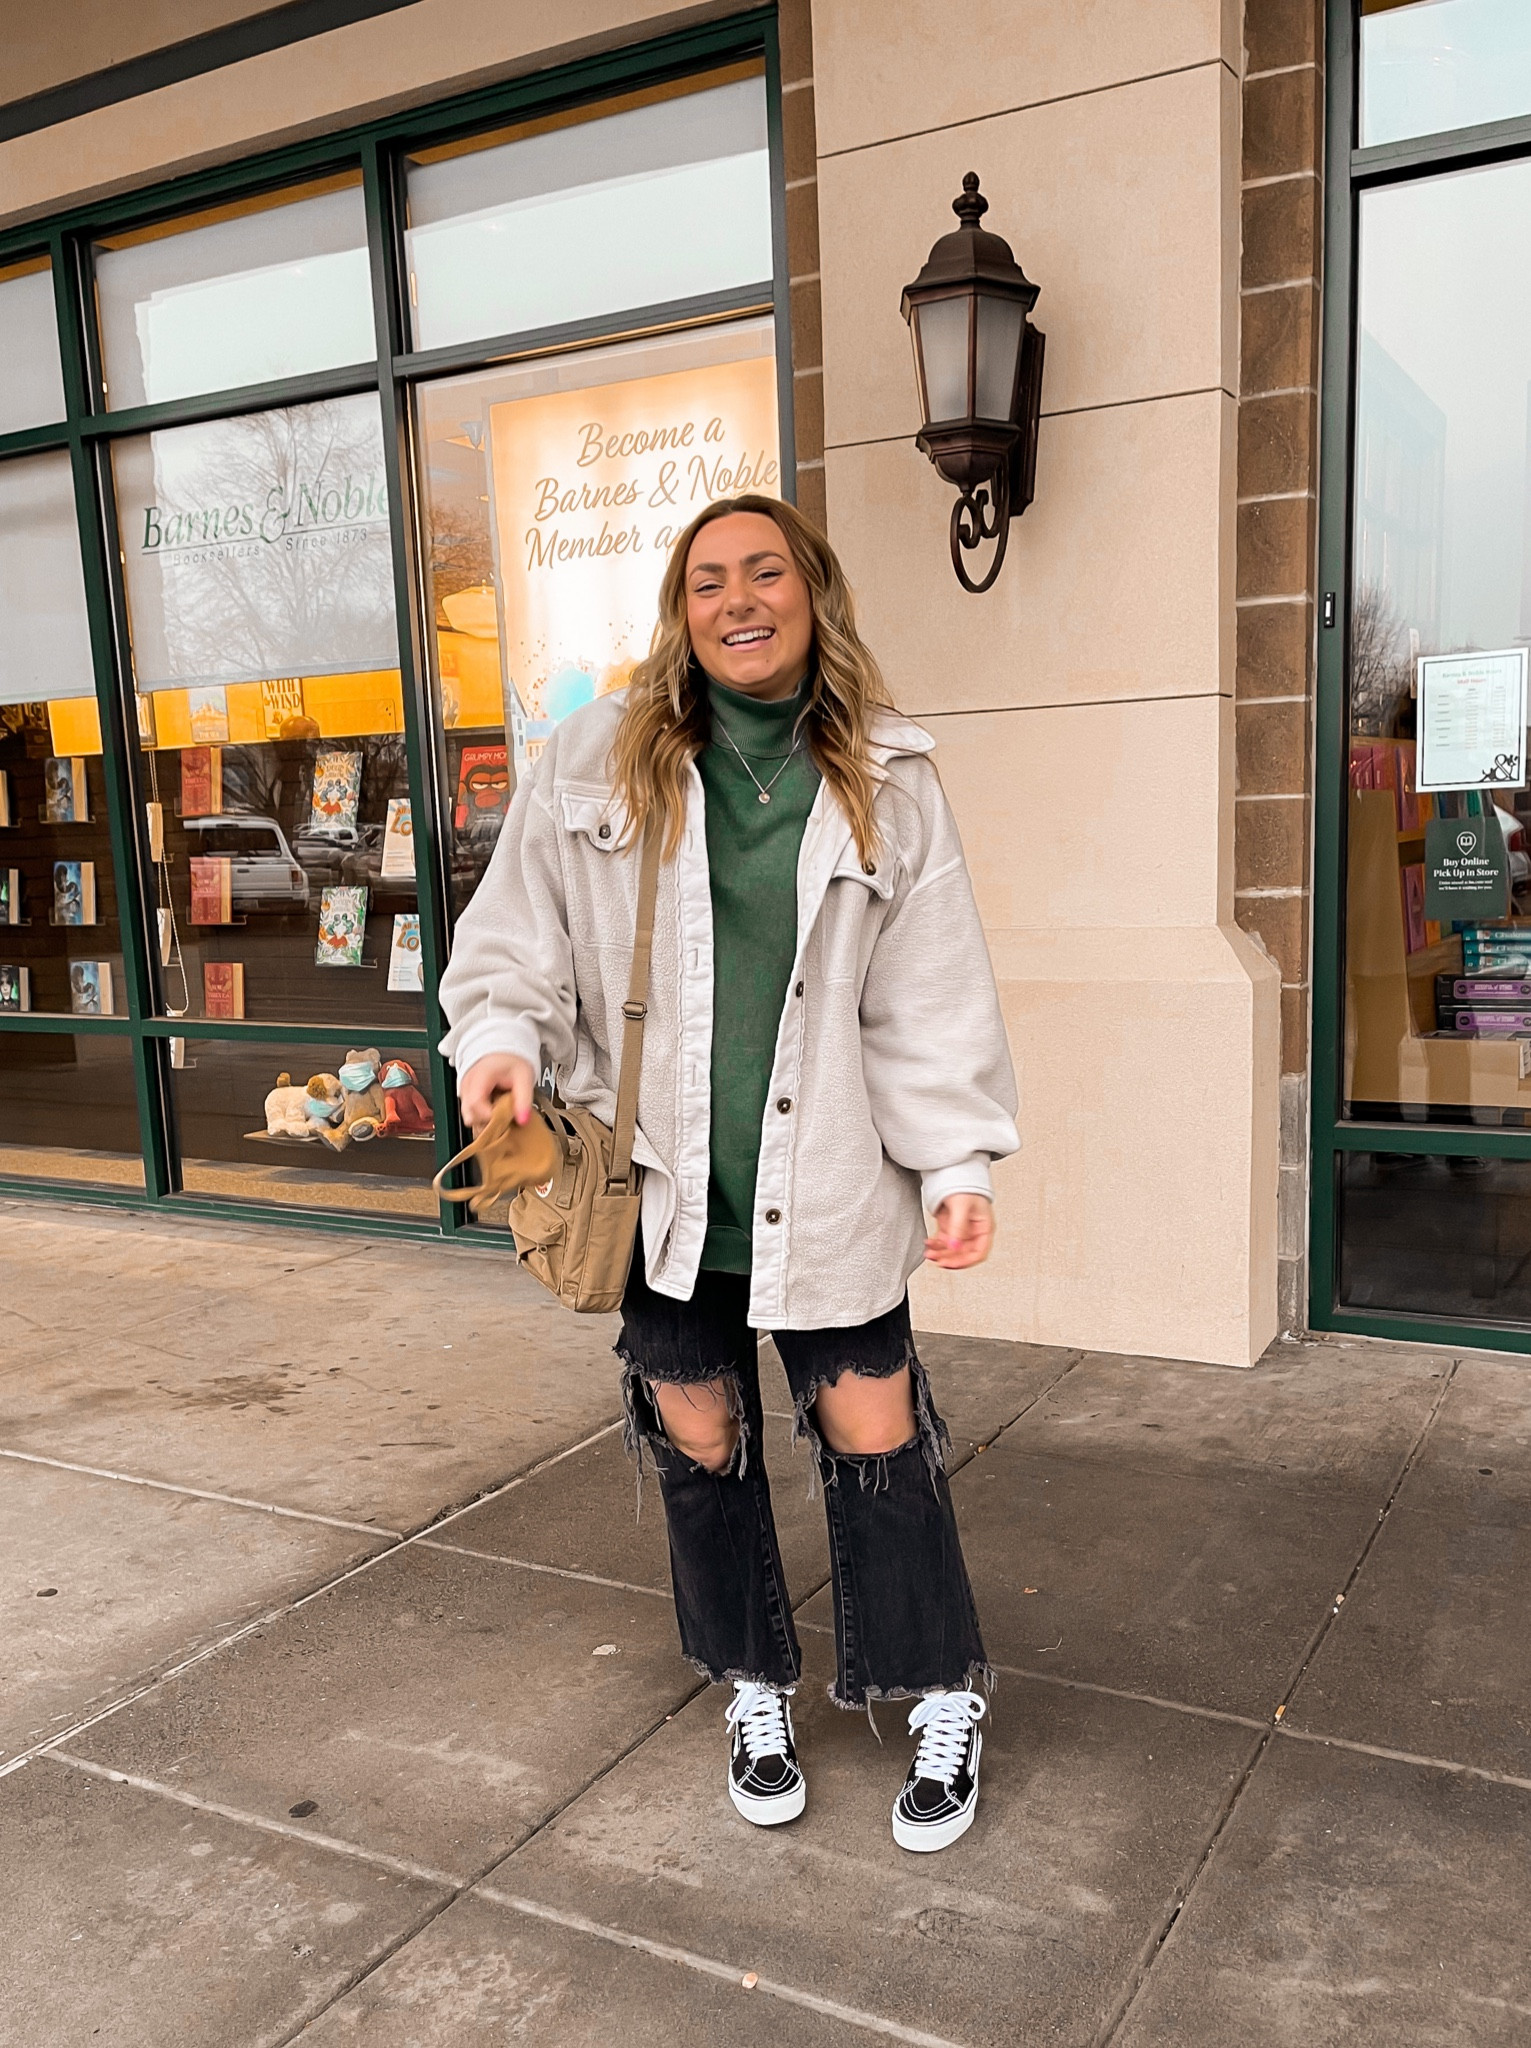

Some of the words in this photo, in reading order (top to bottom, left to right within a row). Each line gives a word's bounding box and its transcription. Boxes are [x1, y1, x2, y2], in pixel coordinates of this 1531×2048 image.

[576, 422, 695, 468] Become
[704, 417, 725, 442] a
[534, 477, 644, 522] Barnes
[648, 461, 679, 509] &
[687, 450, 779, 501] Noble
[141, 501, 255, 549] Barnes
[259, 486, 291, 544] &
[296, 474, 389, 527] Noble
[173, 544, 261, 567] Booksellers
[285, 536, 328, 552] Since
[335, 527, 368, 545] 1873
[525, 521, 644, 572] Member
[270, 692, 301, 709] WIND
[464, 752, 493, 762] GRUMPY
[1433, 869, 1452, 878] Pick
[1452, 869, 1466, 879] Up
[1476, 868, 1499, 876] Store
[1443, 858, 1460, 868] Buy
[1460, 857, 1490, 866] Online
